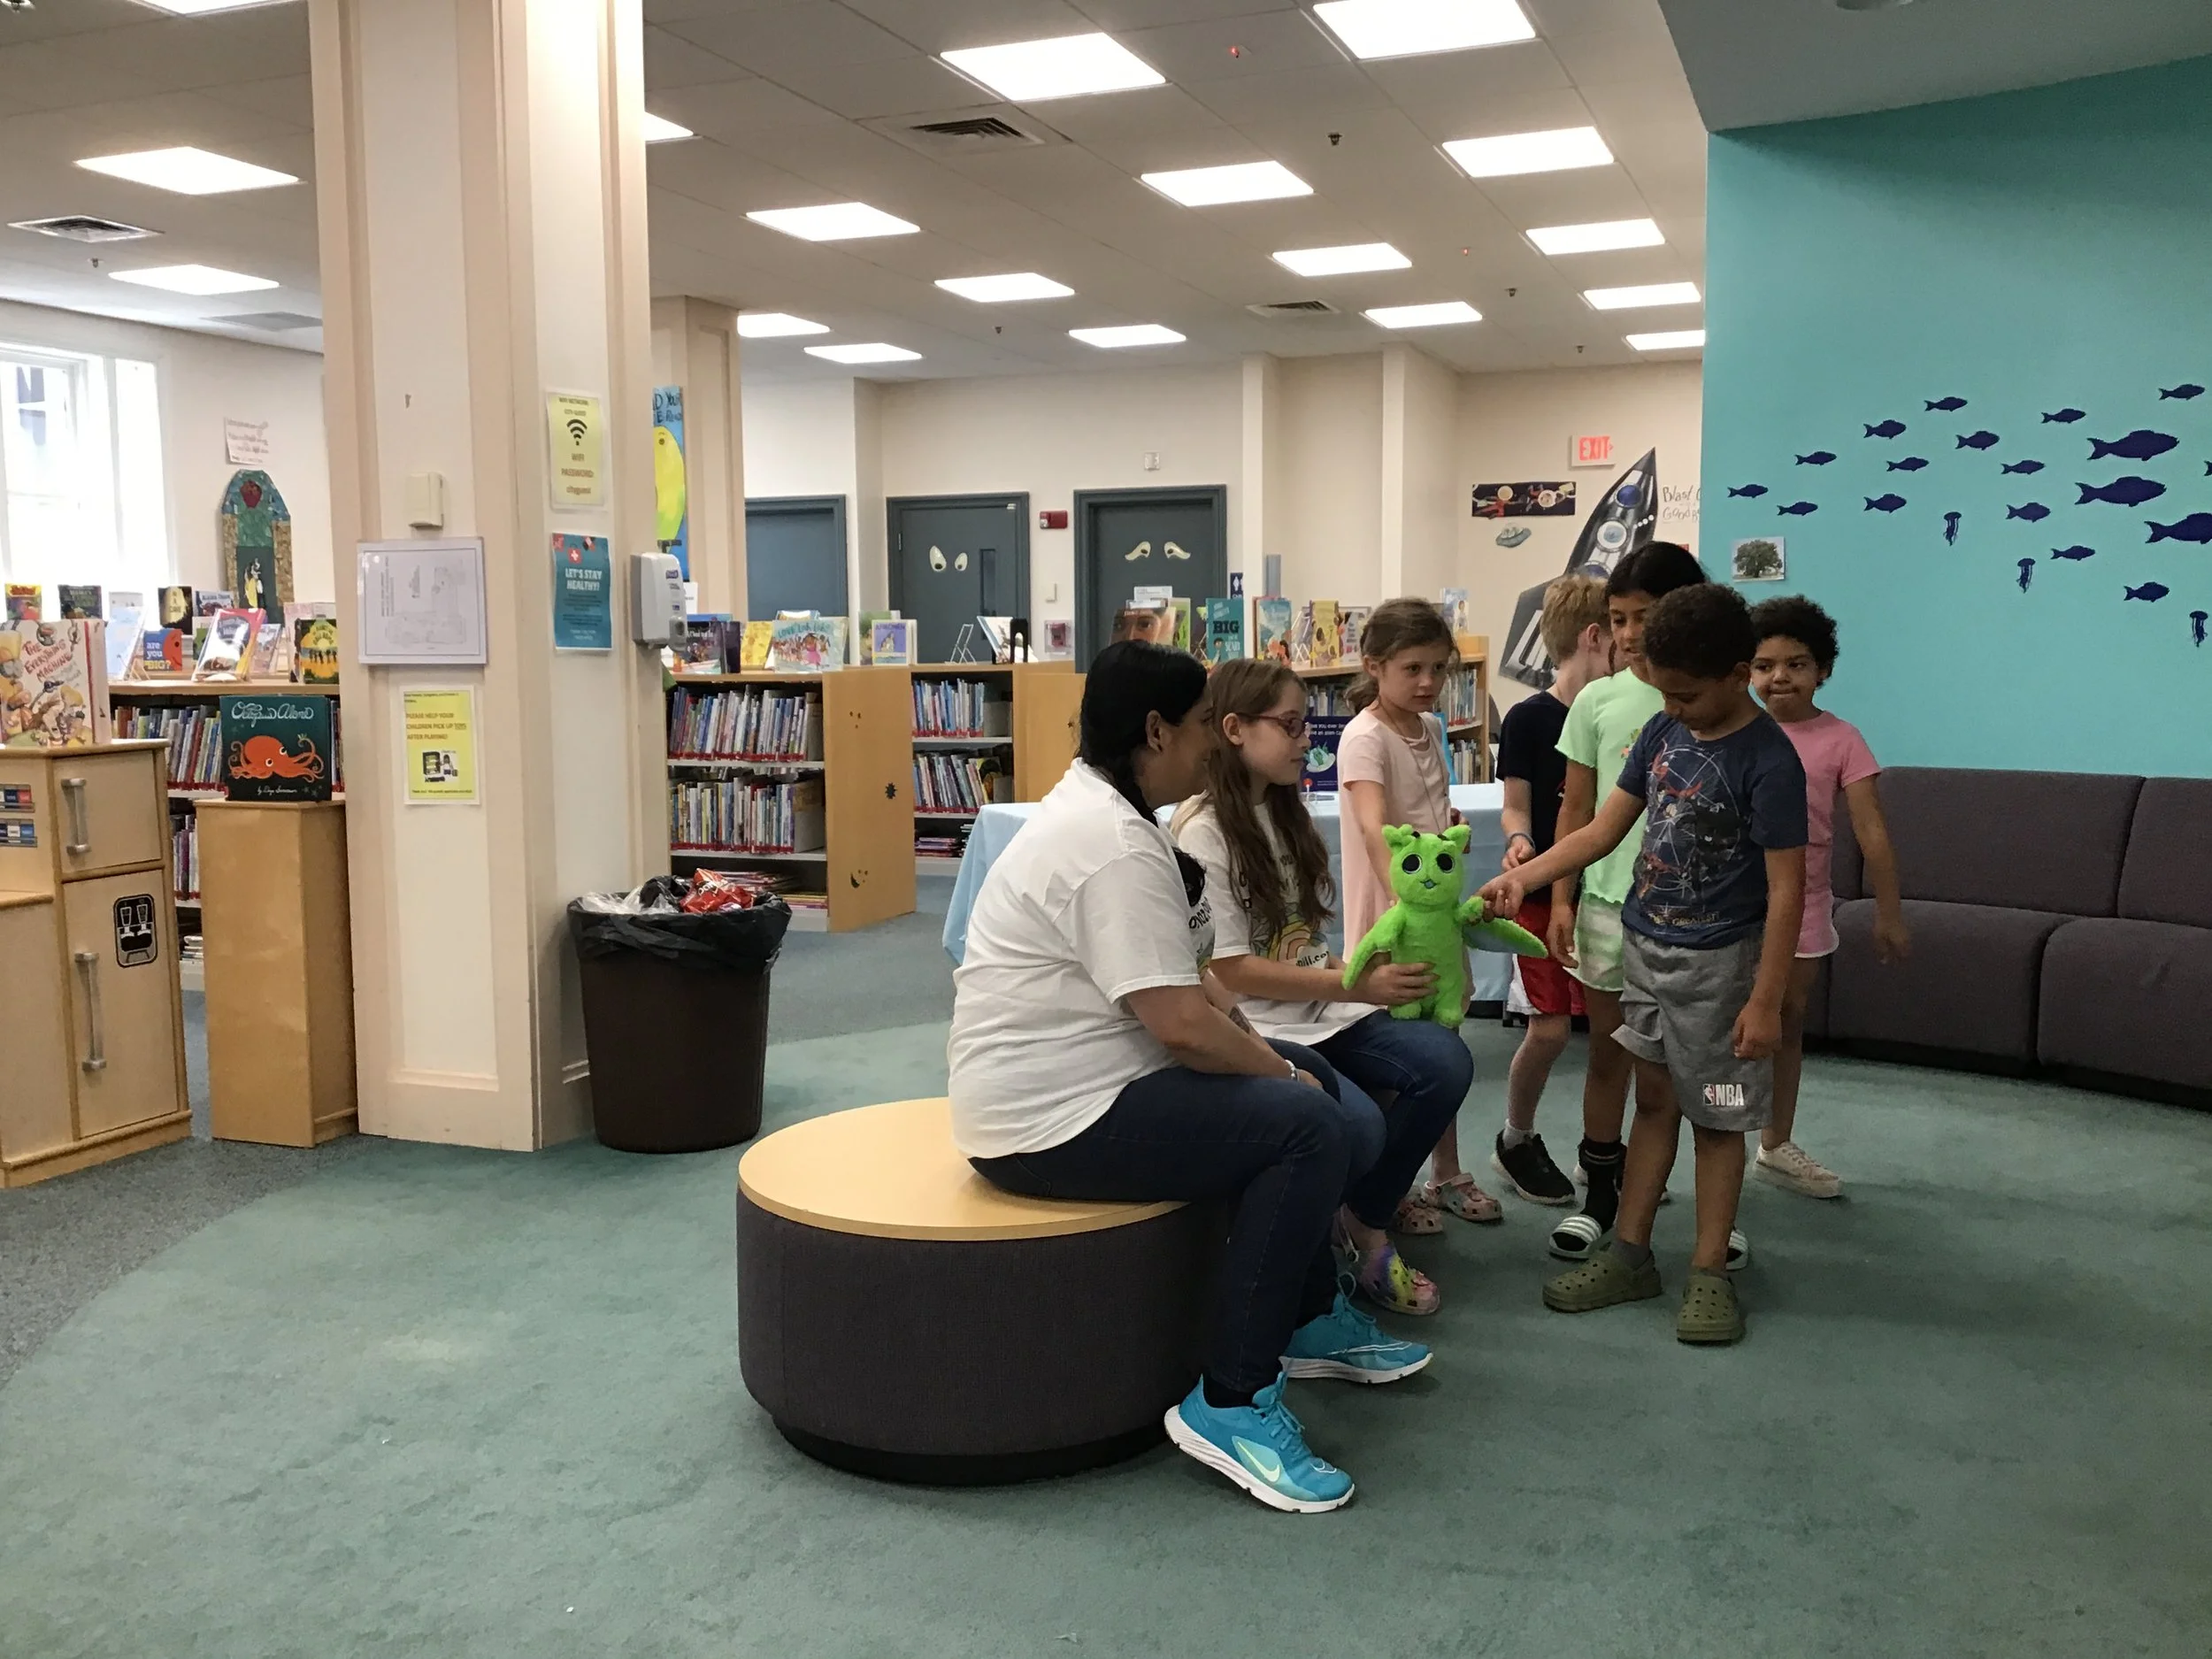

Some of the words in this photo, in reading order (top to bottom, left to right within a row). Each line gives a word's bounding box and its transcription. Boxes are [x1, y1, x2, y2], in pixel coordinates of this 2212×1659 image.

[1578, 435, 1610, 461] EXIT
[565, 567, 583, 579] LET'S
[584, 569, 603, 580] STAY
[1213, 620, 1240, 634] BIG
[22, 640, 42, 656] THE
[146, 650, 163, 659] you
[1715, 1084, 1744, 1106] NBA
